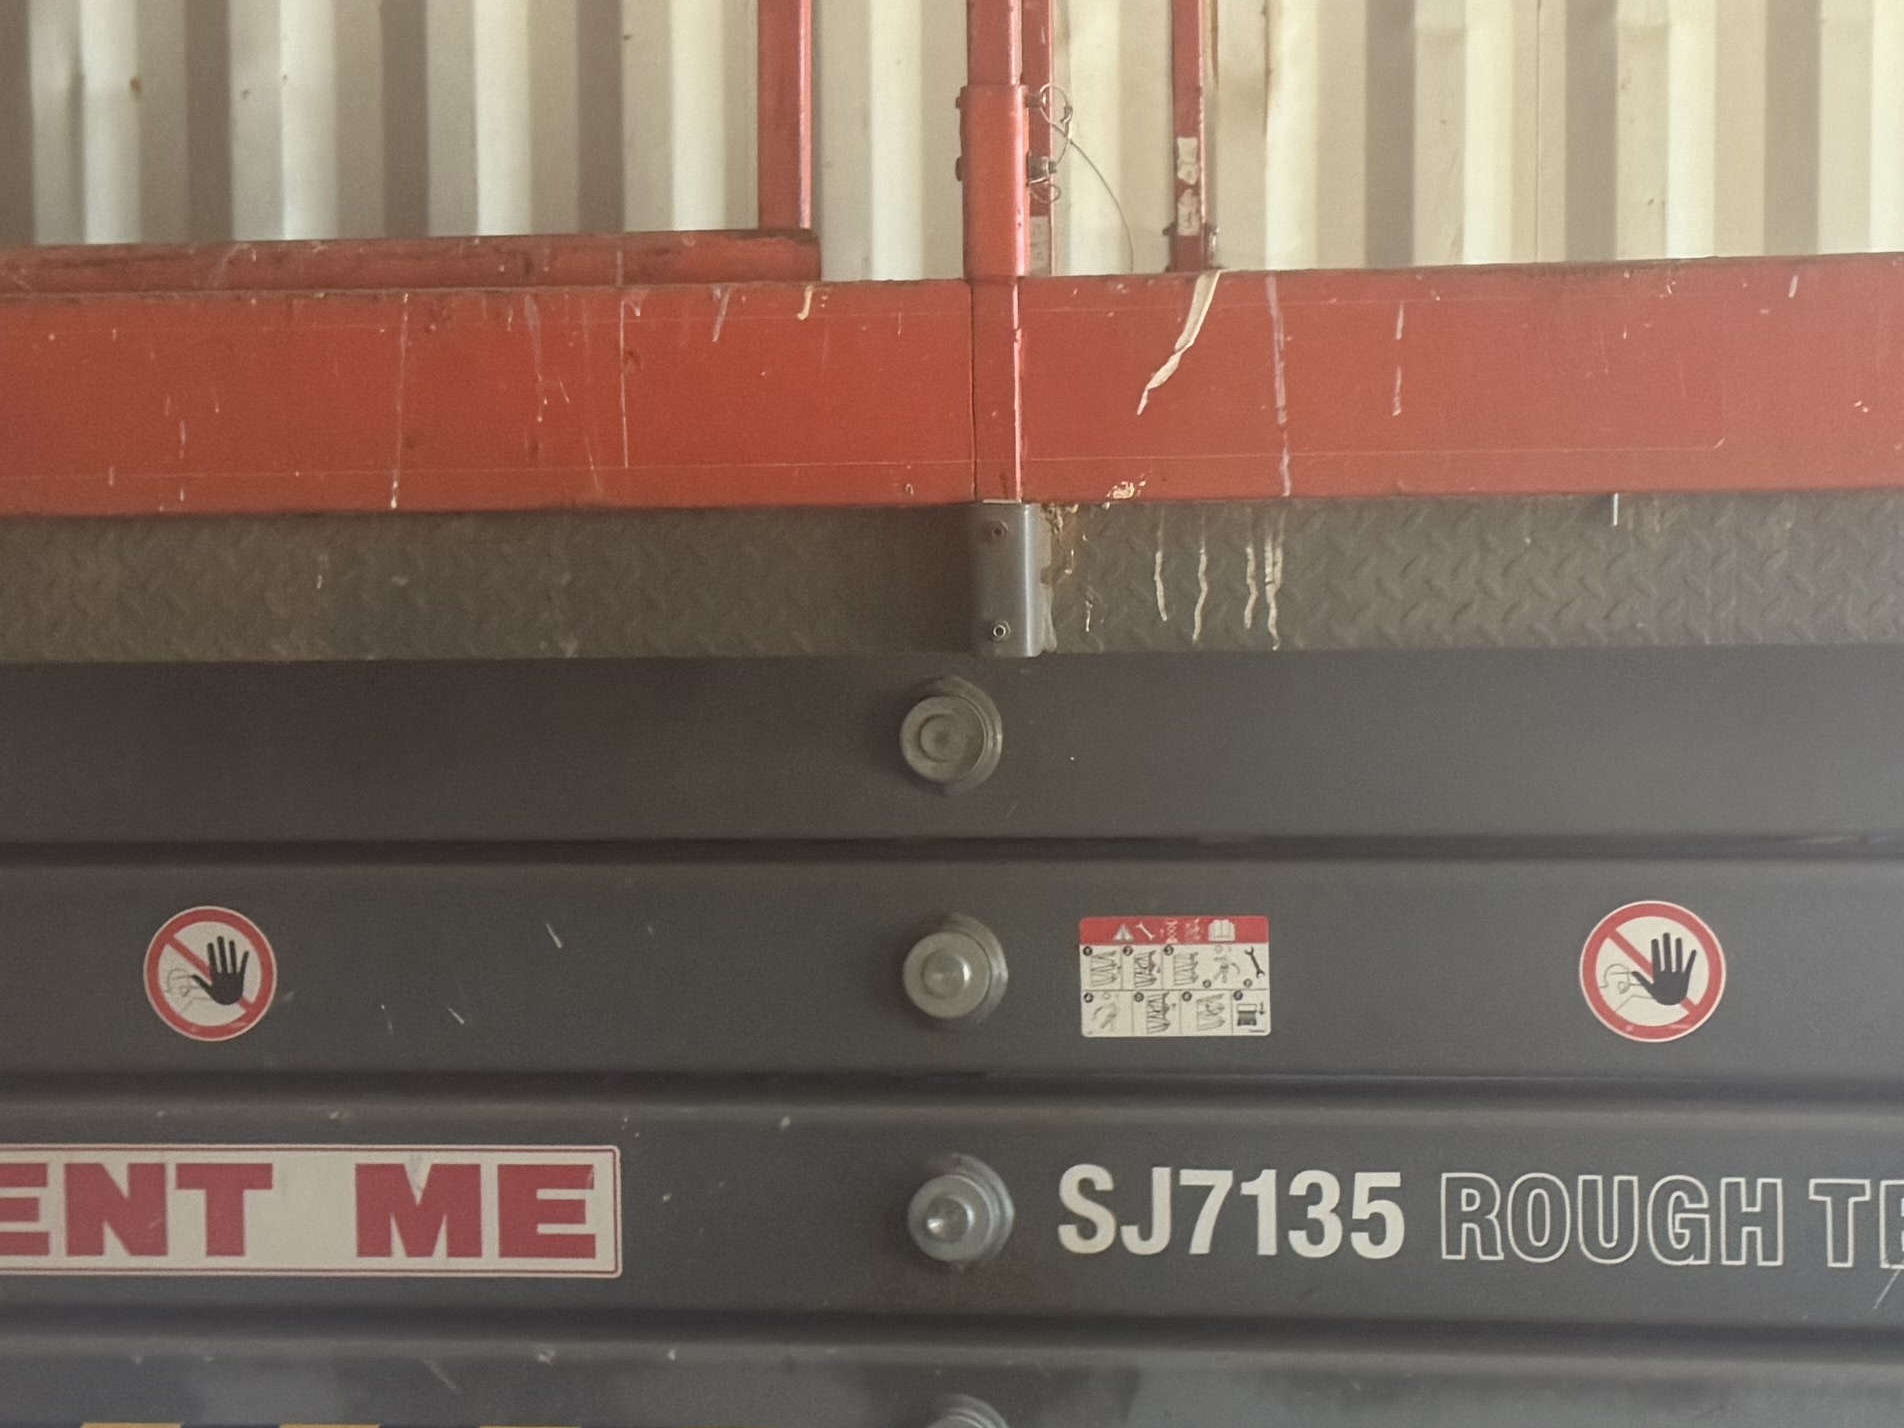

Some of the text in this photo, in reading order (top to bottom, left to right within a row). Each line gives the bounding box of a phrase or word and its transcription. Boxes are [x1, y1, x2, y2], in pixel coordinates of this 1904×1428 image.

[354, 1163, 597, 1259] ME
[1055, 1164, 1406, 1260] SJ7135
[1440, 1172, 1786, 1269] ROUGH
